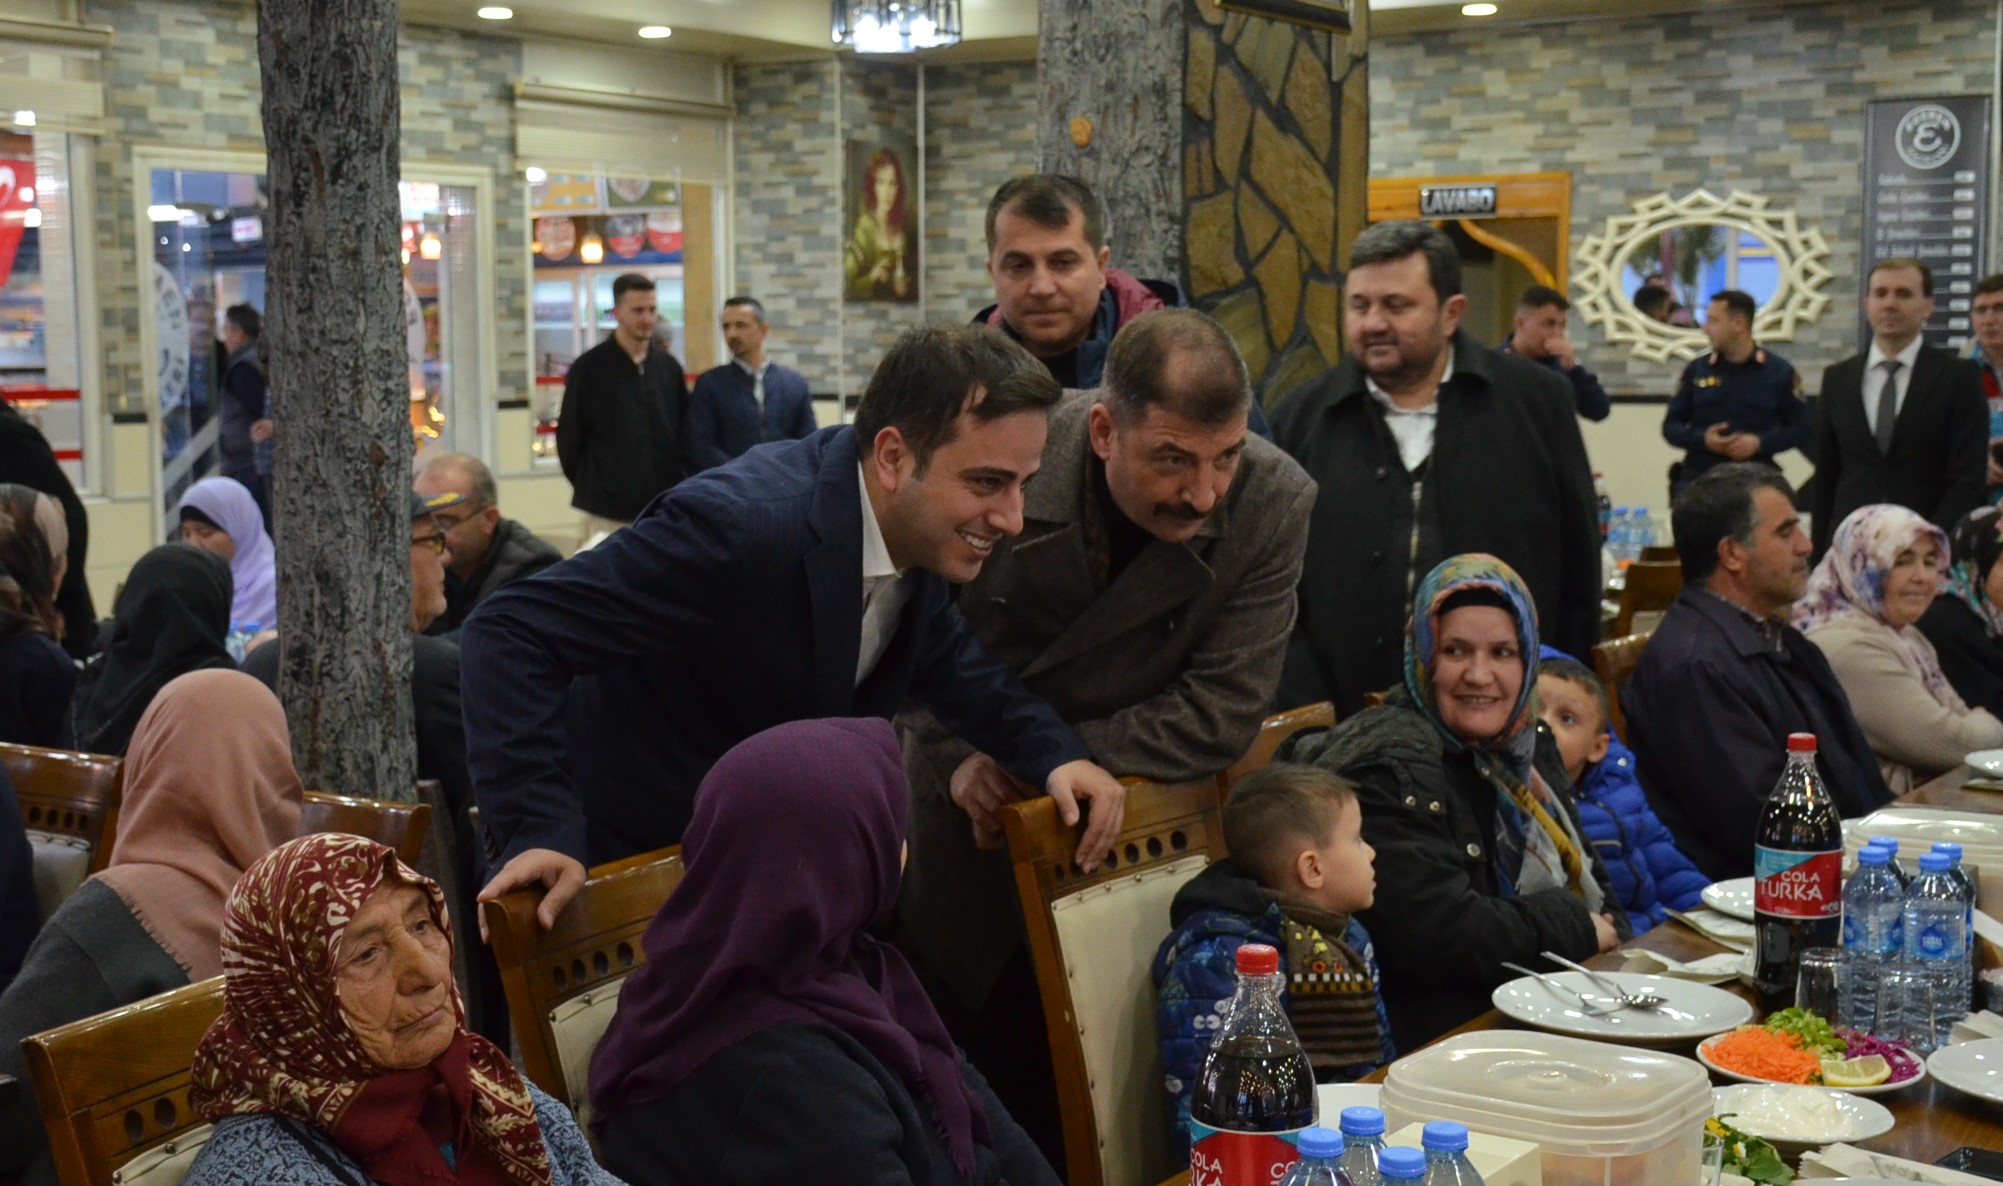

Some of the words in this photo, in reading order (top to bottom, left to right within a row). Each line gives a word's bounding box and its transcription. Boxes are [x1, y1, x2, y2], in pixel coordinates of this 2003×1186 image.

[1421, 188, 1495, 214] LAVABO
[1781, 870, 1820, 883] COLA
[1757, 878, 1823, 902] TURKA
